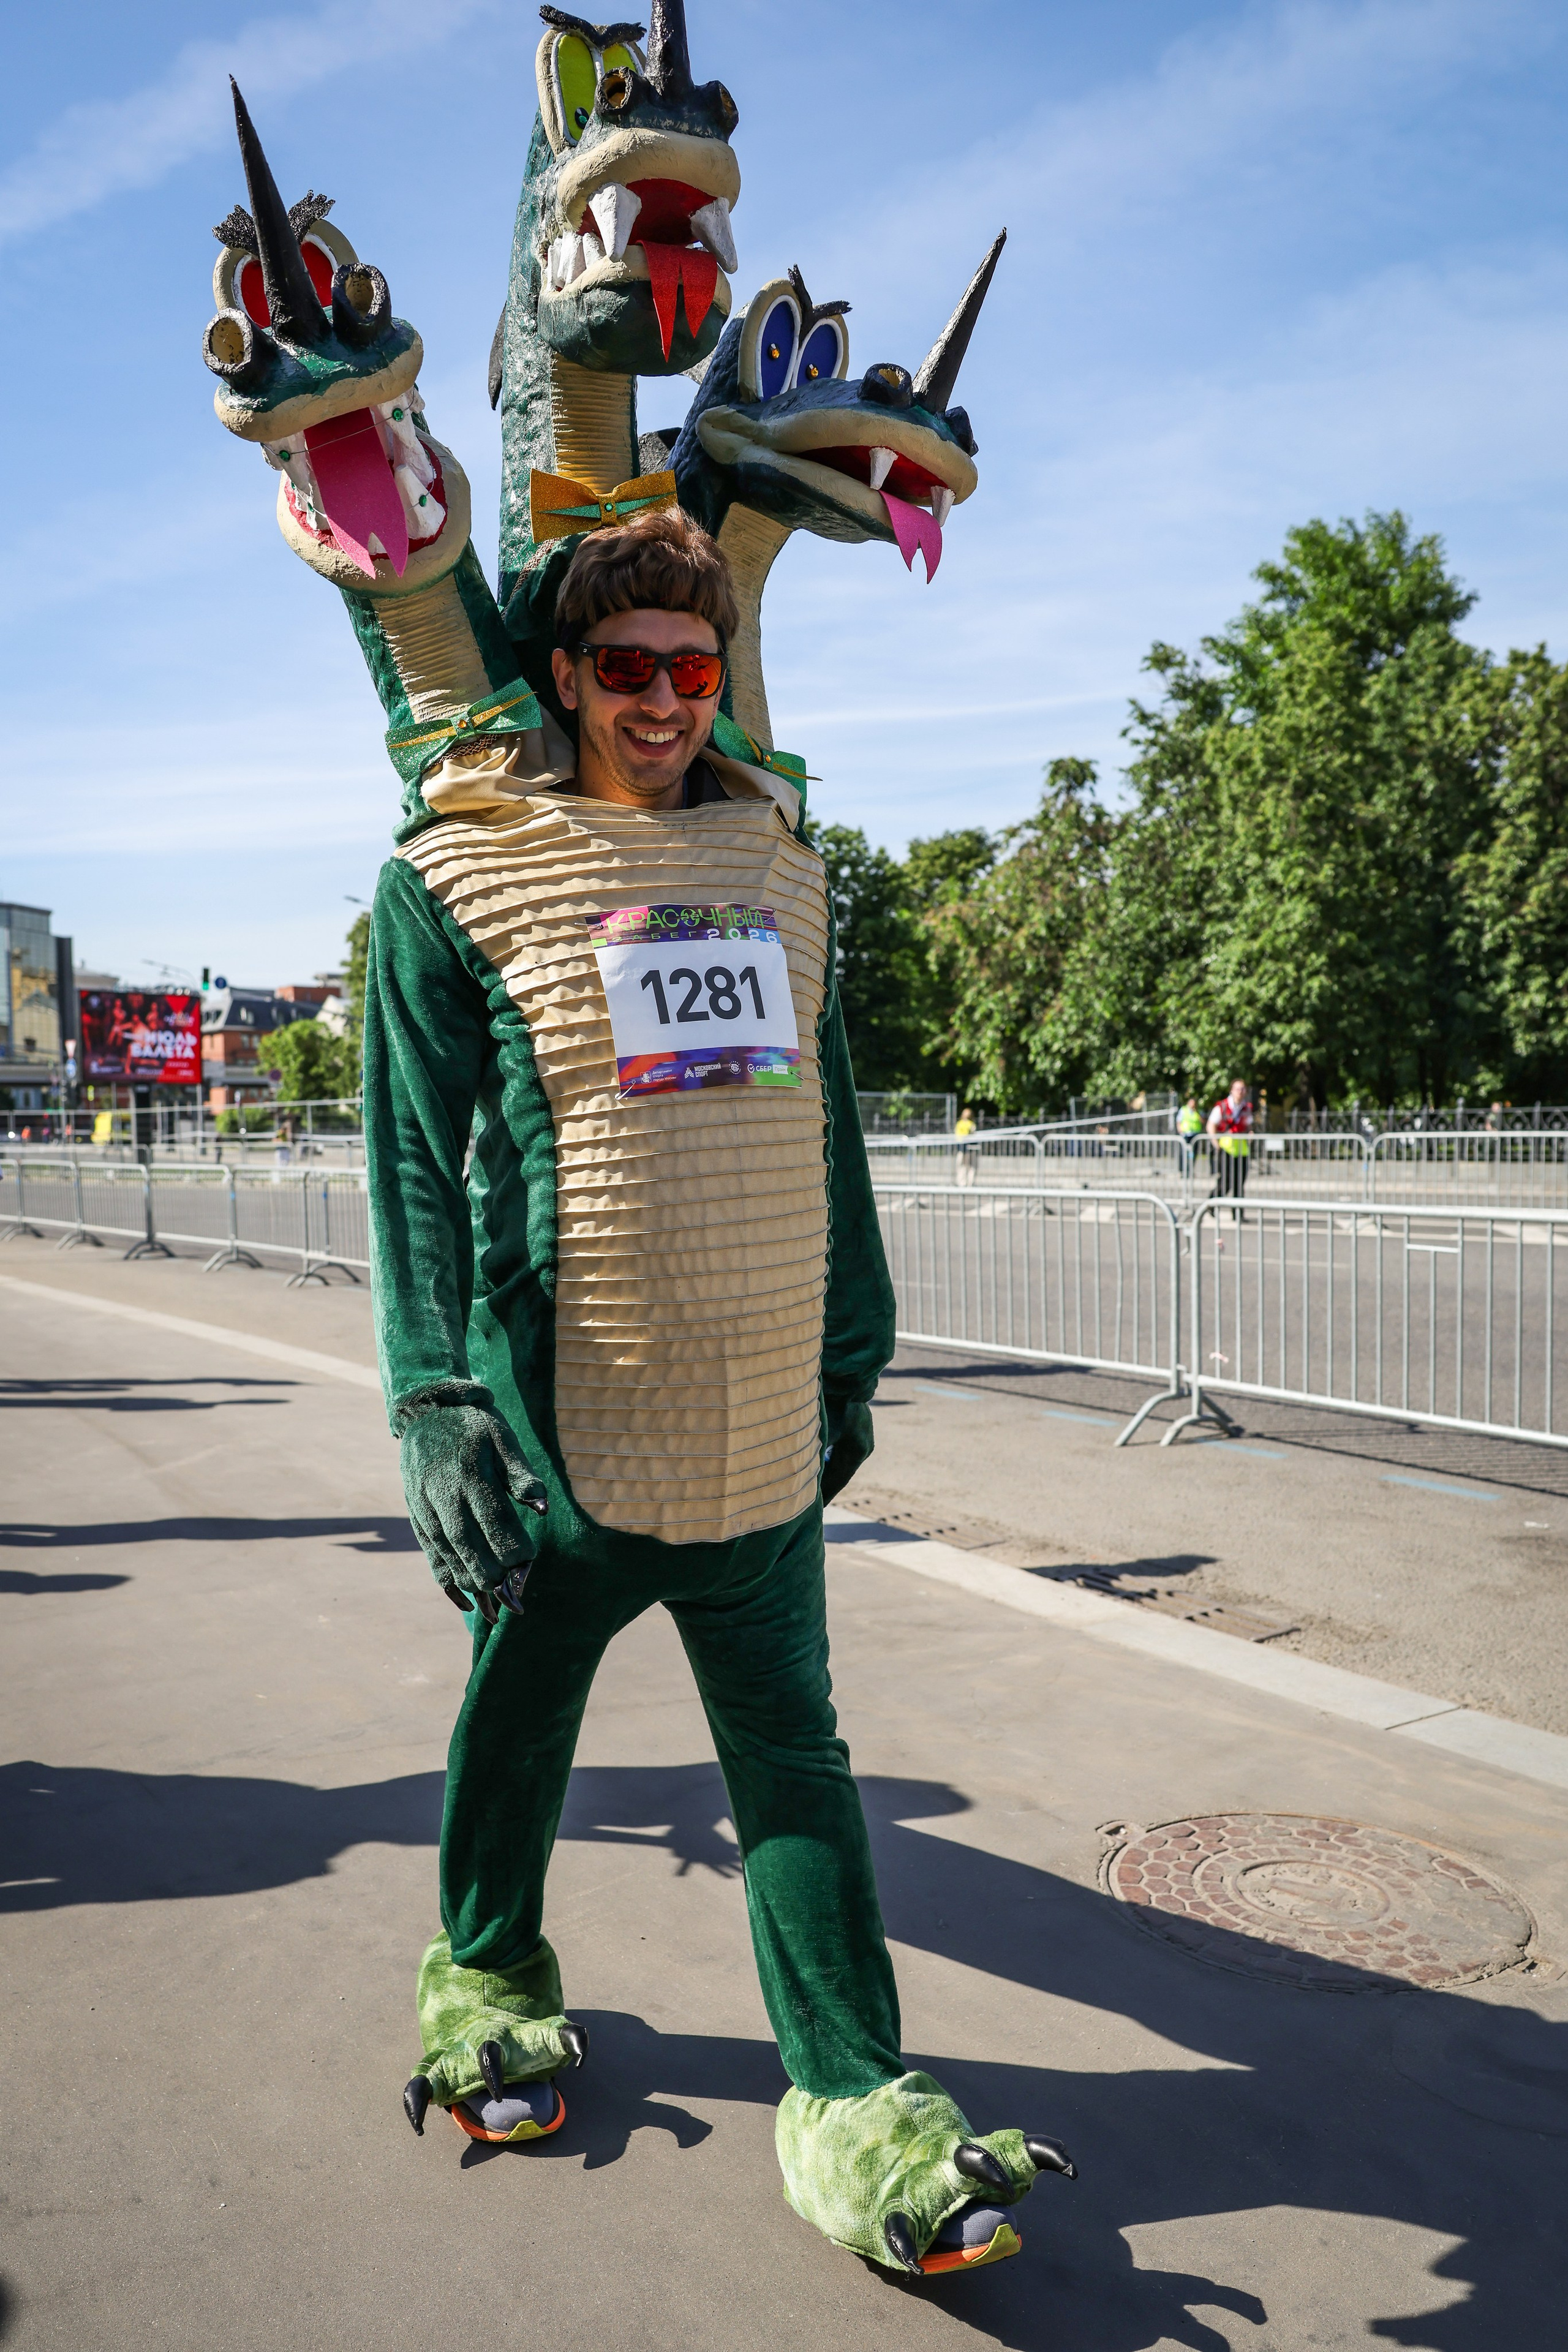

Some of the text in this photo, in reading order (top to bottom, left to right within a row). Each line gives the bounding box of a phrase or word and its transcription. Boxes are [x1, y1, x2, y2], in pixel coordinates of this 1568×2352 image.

[607, 907, 764, 933] КРАСОЧНЫЙ
[612, 928, 777, 943] ЗАБЕГ 2026
[640, 966, 766, 1025] 1281
[694, 1063, 722, 1071] МОСКОВСКИЙ
